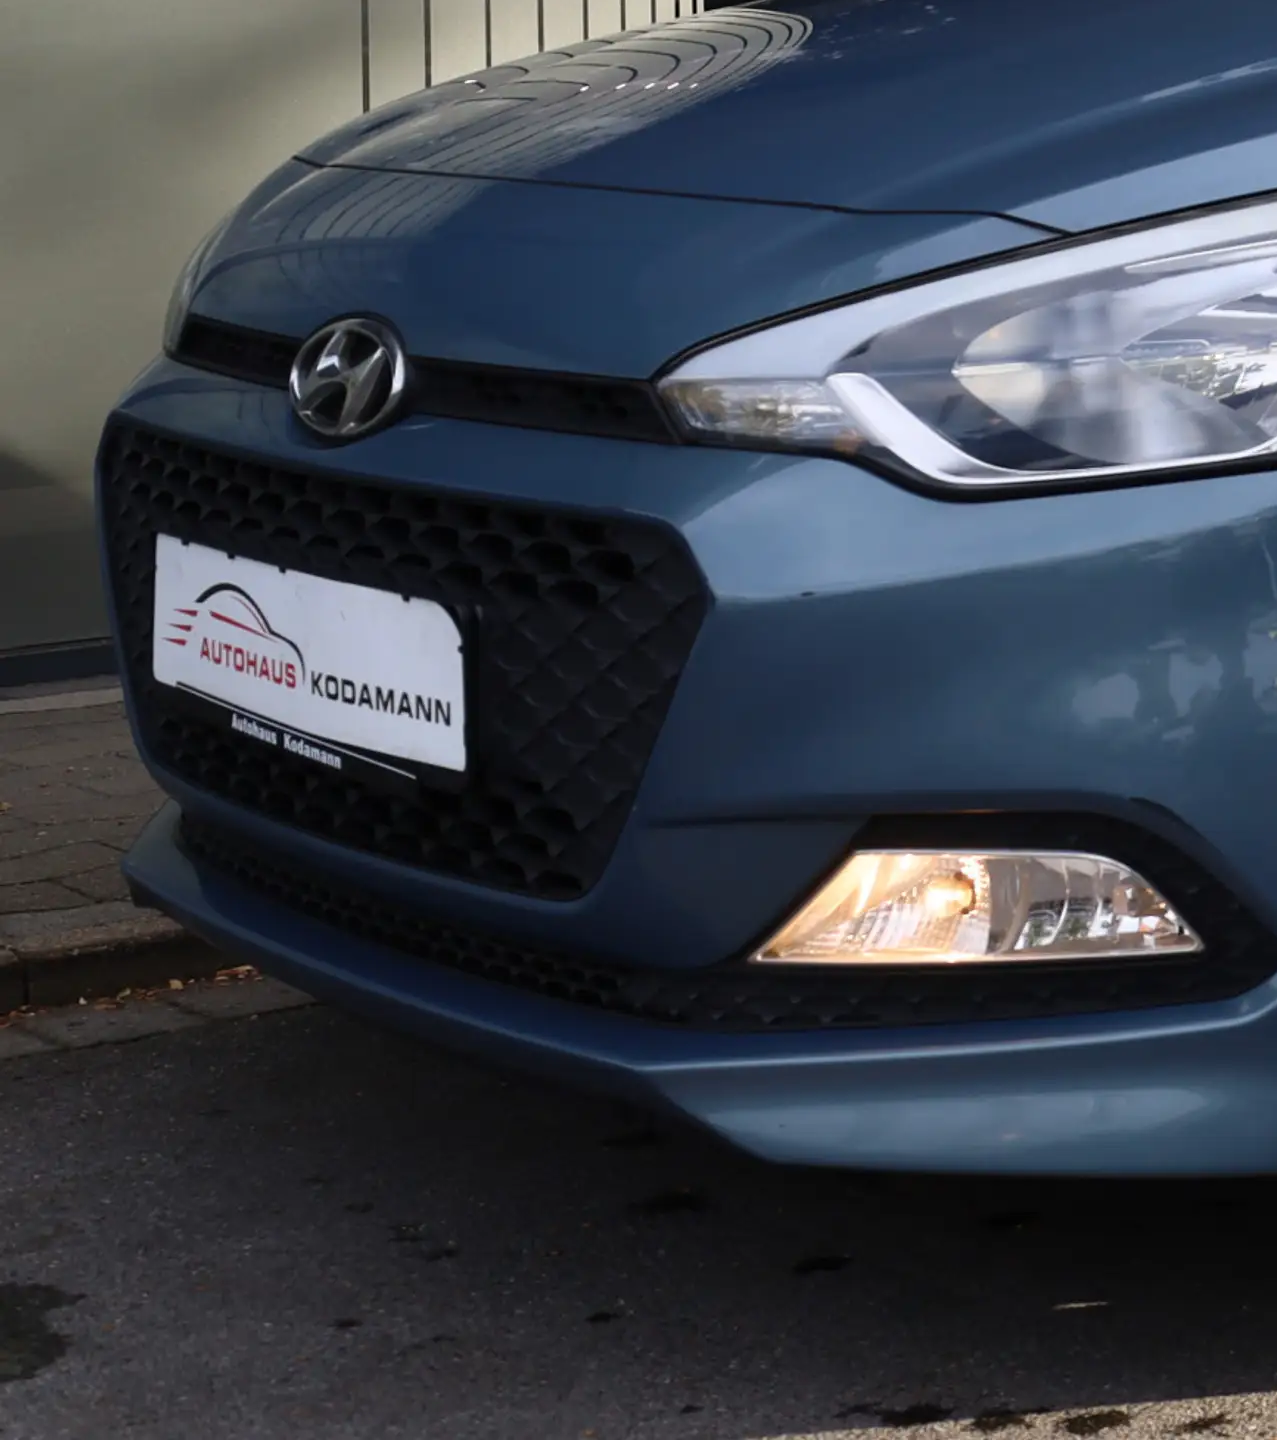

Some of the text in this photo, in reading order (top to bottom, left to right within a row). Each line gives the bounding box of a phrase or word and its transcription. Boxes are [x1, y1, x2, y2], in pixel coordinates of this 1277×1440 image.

[199, 637, 453, 727] AUTOHAUS KODAMANN
[231, 712, 342, 771] Autohaus Kodamann
